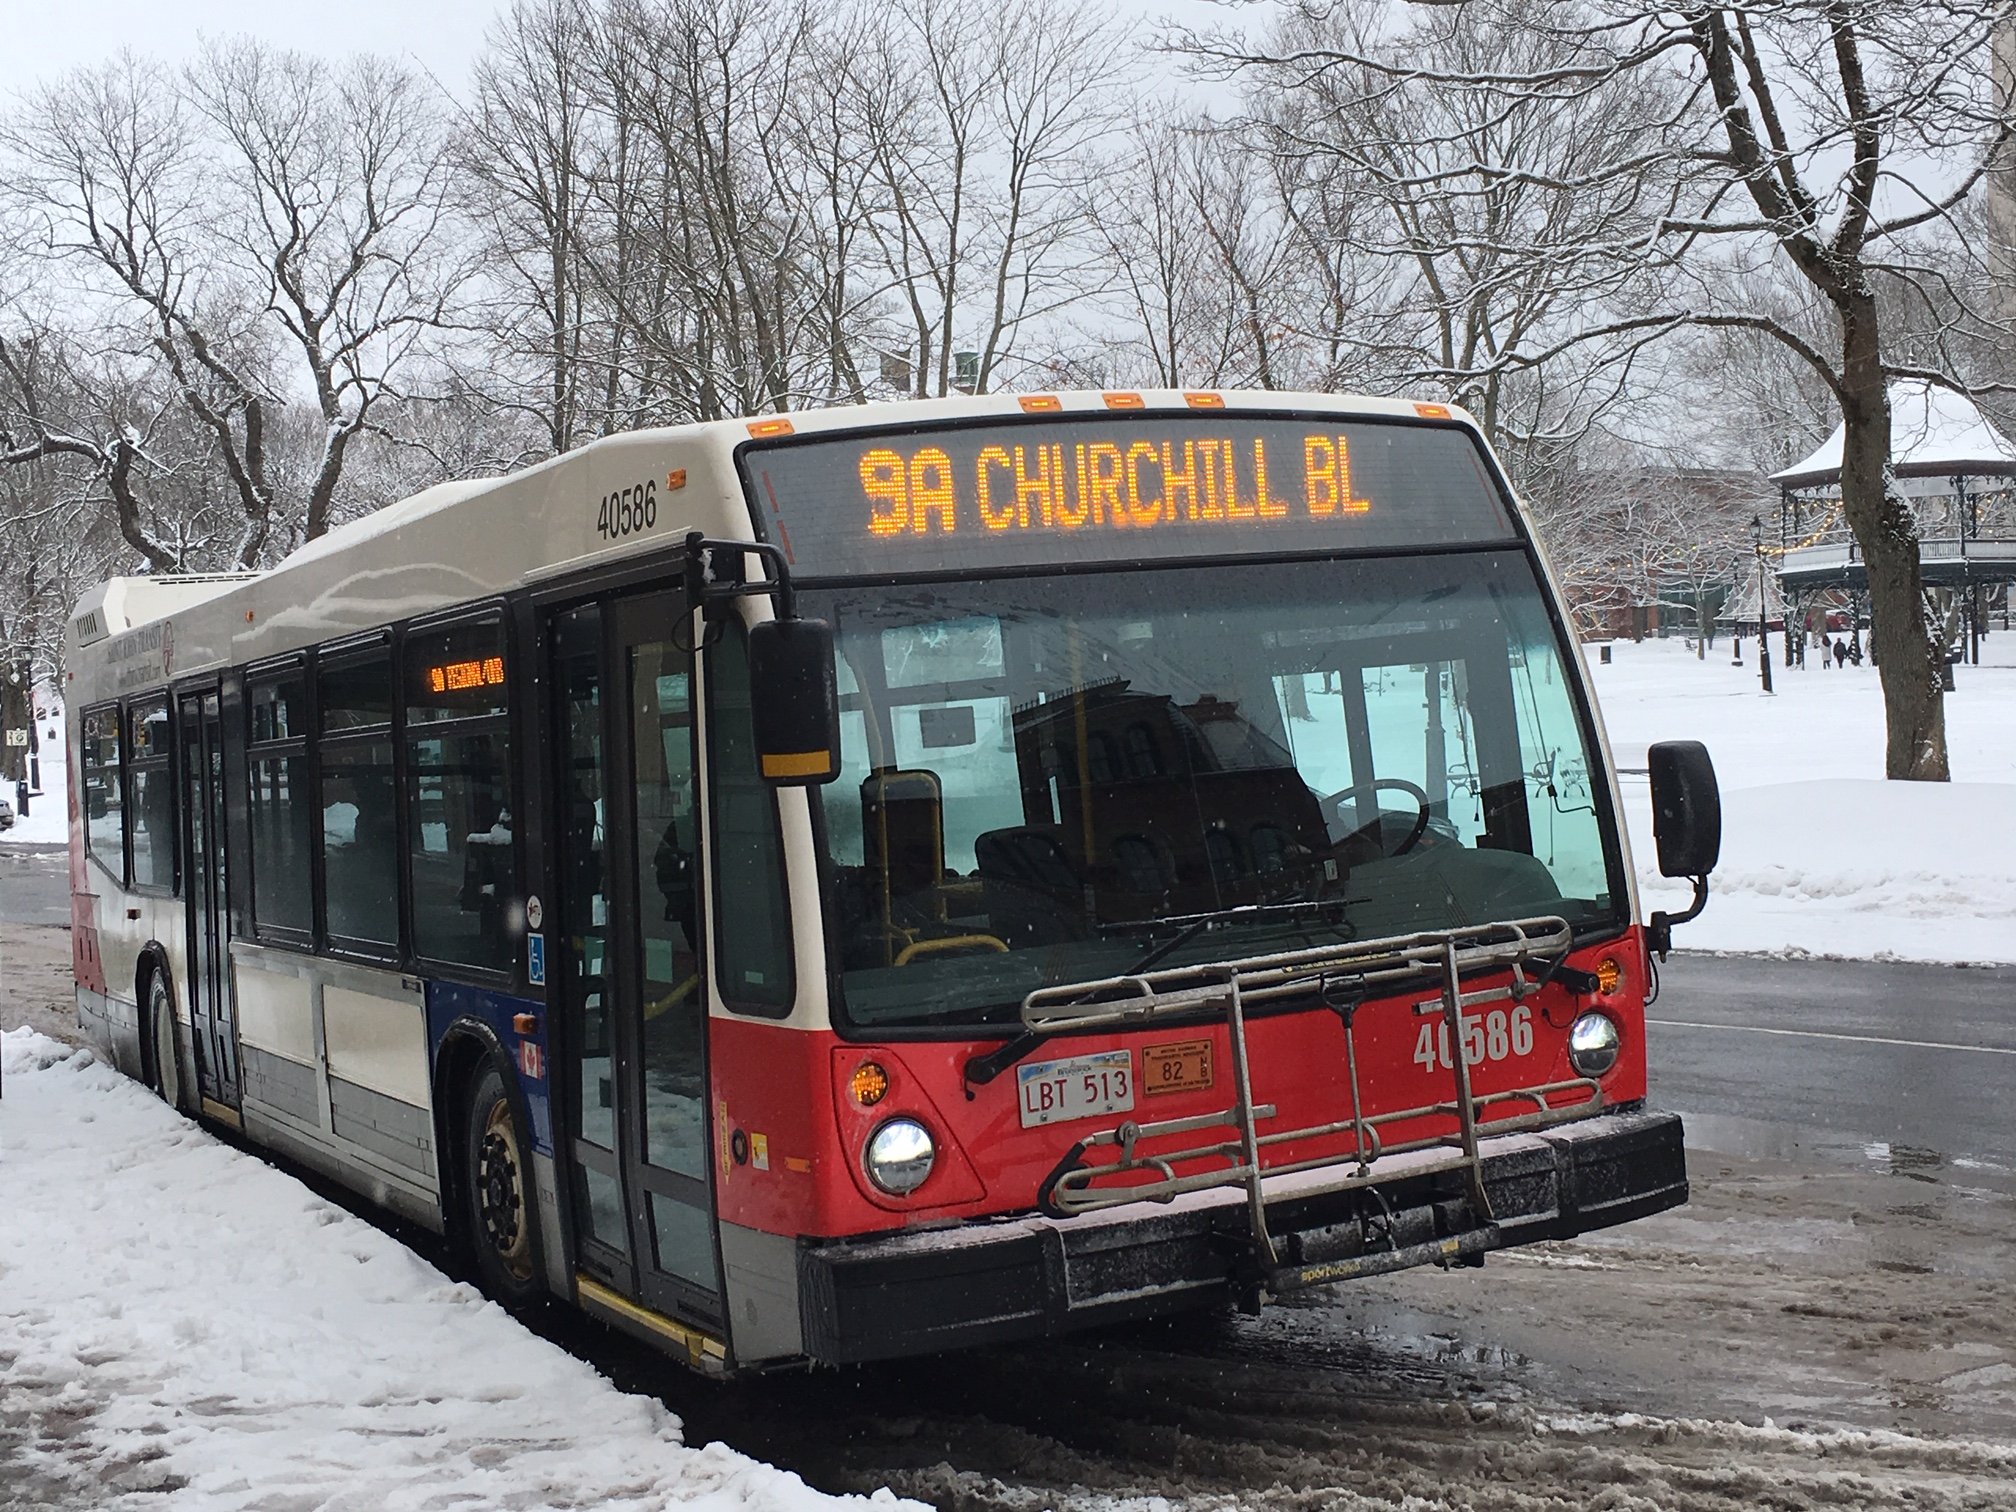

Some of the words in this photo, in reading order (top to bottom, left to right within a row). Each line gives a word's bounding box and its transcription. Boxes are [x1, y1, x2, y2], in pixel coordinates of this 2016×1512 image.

[597, 479, 657, 540] 40586
[858, 447, 955, 536] 9A
[976, 438, 1287, 529] CHURCHILL
[1304, 435, 1370, 514] BL
[1026, 1078, 1068, 1114] LBT
[1083, 1070, 1128, 1104] 513
[1162, 1060, 1184, 1082] 82
